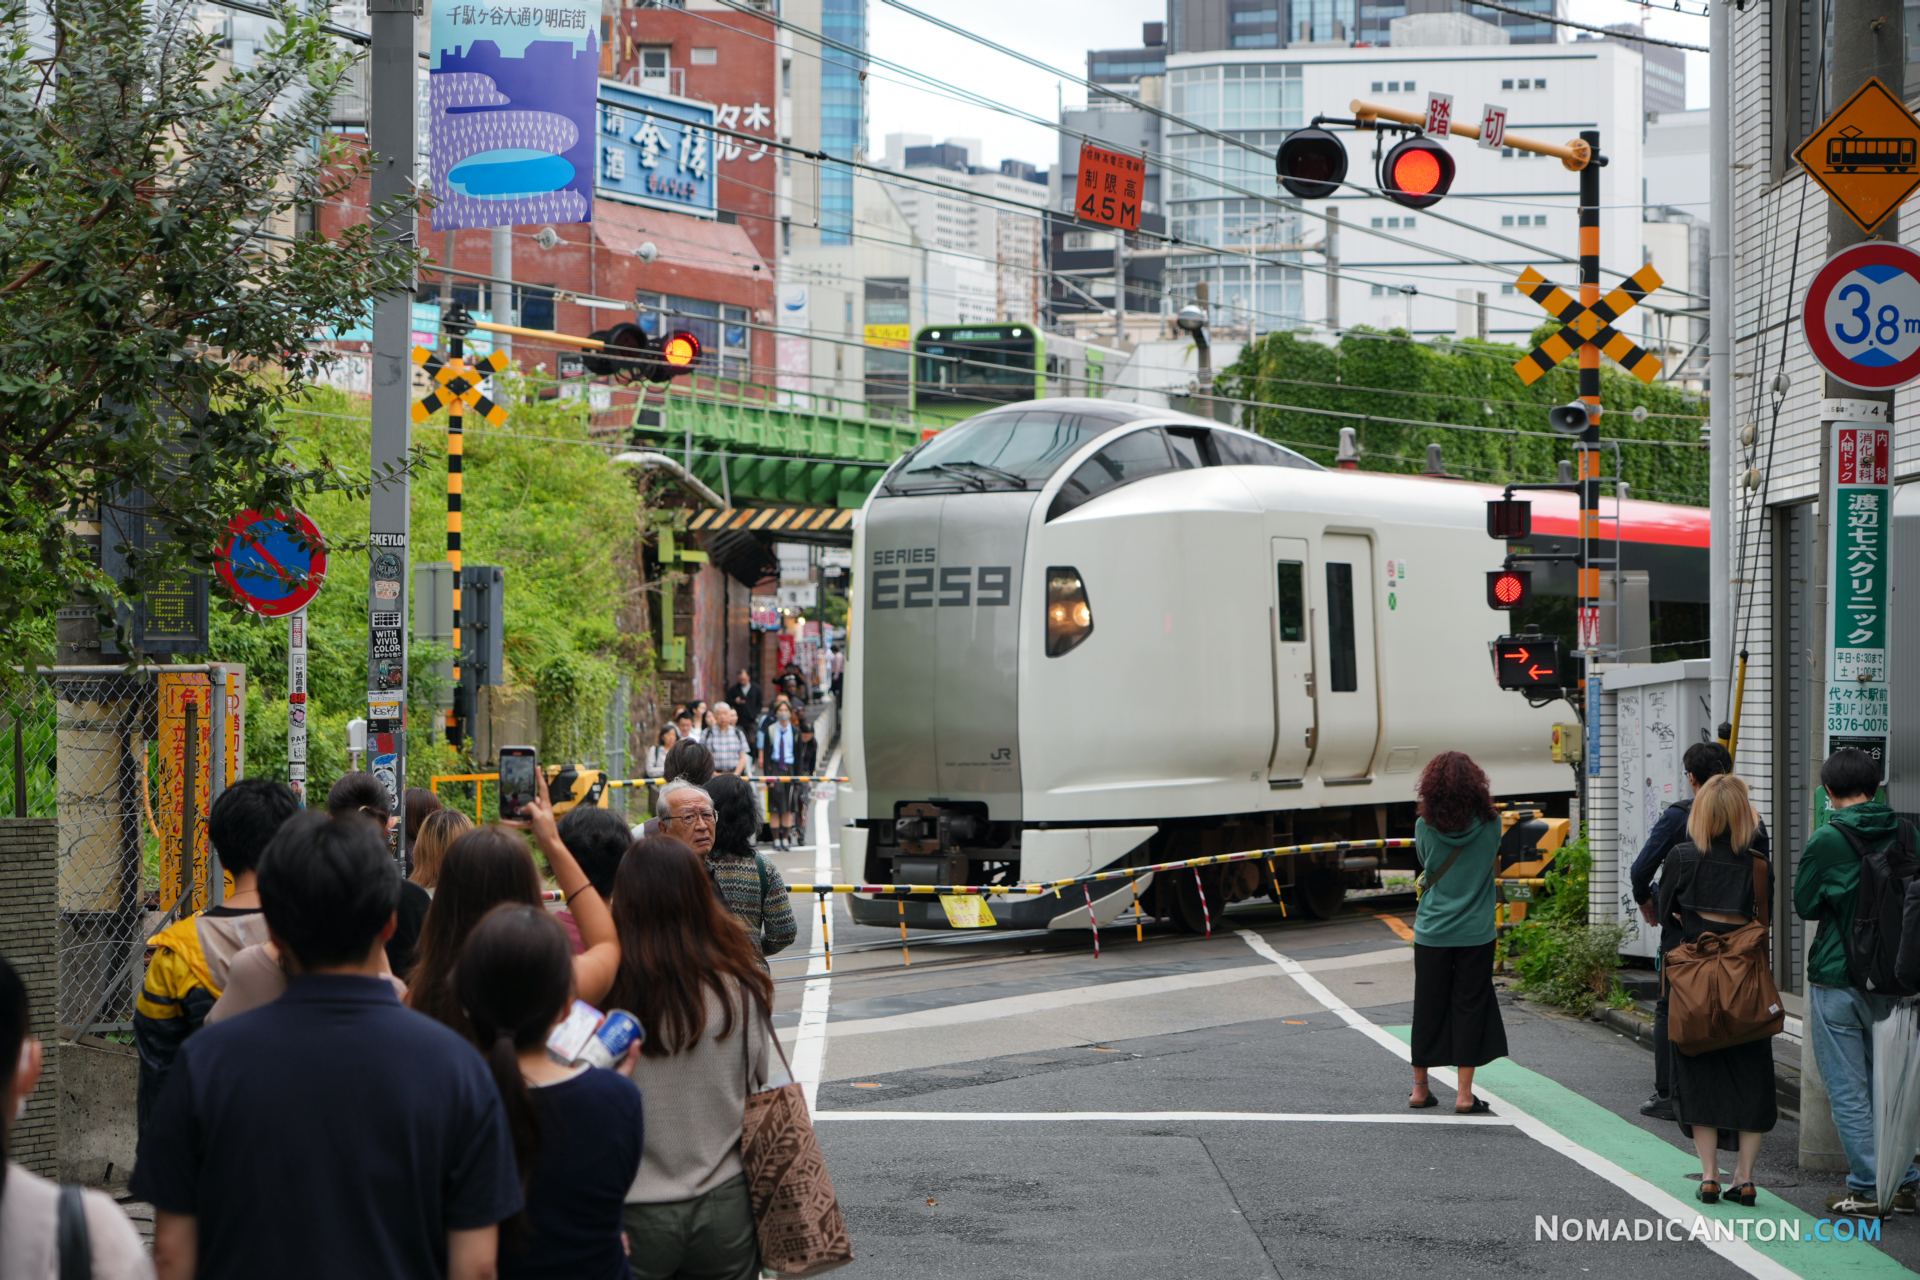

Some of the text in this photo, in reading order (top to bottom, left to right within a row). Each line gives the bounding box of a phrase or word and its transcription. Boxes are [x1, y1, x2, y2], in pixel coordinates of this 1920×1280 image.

[447, 5, 586, 29] 千駄ヶ谷大通り明店街
[1084, 168, 1137, 199] 制限高
[1081, 193, 1136, 226] 4.5M
[1840, 431, 1854, 482] 人間ドック
[1876, 432, 1888, 482] 内科
[370, 533, 405, 547] SKEYLO
[873, 548, 936, 566] SERIES
[1847, 493, 1879, 645] 渡辺七六クリニック
[872, 566, 1011, 610] E259
[375, 630, 397, 639] WITH
[376, 637, 399, 646] VIVID
[374, 645, 401, 653] COLOR
[1828, 687, 1888, 702] 代々木駅前
[1827, 717, 1888, 732] 3376-0076
[990, 747, 1012, 760] JR
[1513, 887, 1531, 898] 25
